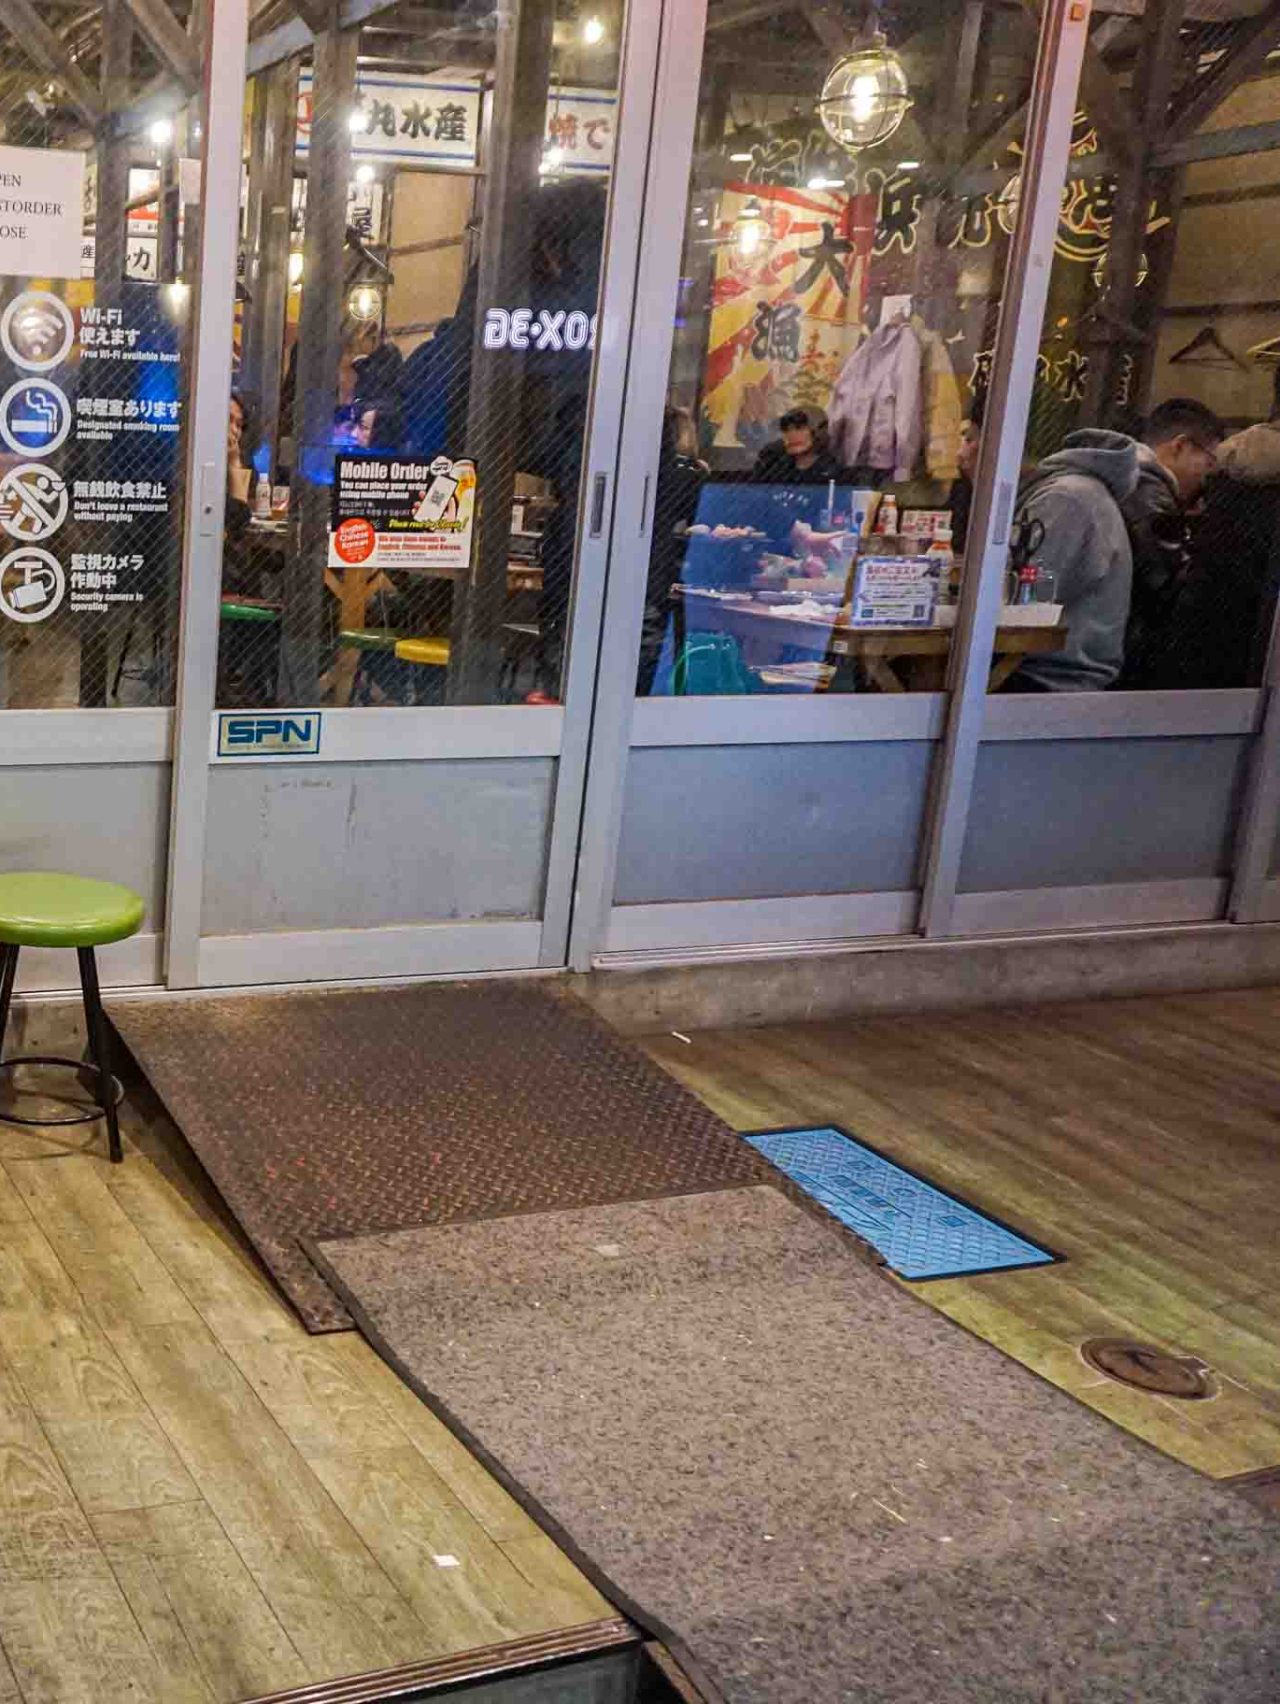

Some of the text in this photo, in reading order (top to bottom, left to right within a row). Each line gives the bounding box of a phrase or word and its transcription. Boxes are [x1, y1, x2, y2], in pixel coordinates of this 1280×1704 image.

[80, 308, 123, 325] Wi-Fi
[79, 327, 141, 347] 使えます
[80, 349, 98, 359] Free
[99, 350, 120, 359] Wi-Fi
[122, 351, 158, 361] available
[76, 398, 182, 418] 喫煙室あります
[77, 419, 180, 433] Designated smoking room
[76, 431, 113, 441] available
[340, 461, 388, 479] Mobile
[390, 462, 430, 480] Order
[73, 480, 167, 499] 無銭飲食禁止
[340, 481, 354, 489] You
[370, 481, 390, 490] place
[74, 501, 96, 511] Don't
[97, 503, 119, 511] leave
[126, 503, 168, 512] restaurant
[73, 512, 133, 523] without paying
[70, 553, 145, 571] 監視カメラ
[70, 572, 117, 589] 作動中
[70, 592, 144, 602] Security camera is
[70, 603, 109, 613] operating
[228, 720, 311, 743] SPN
